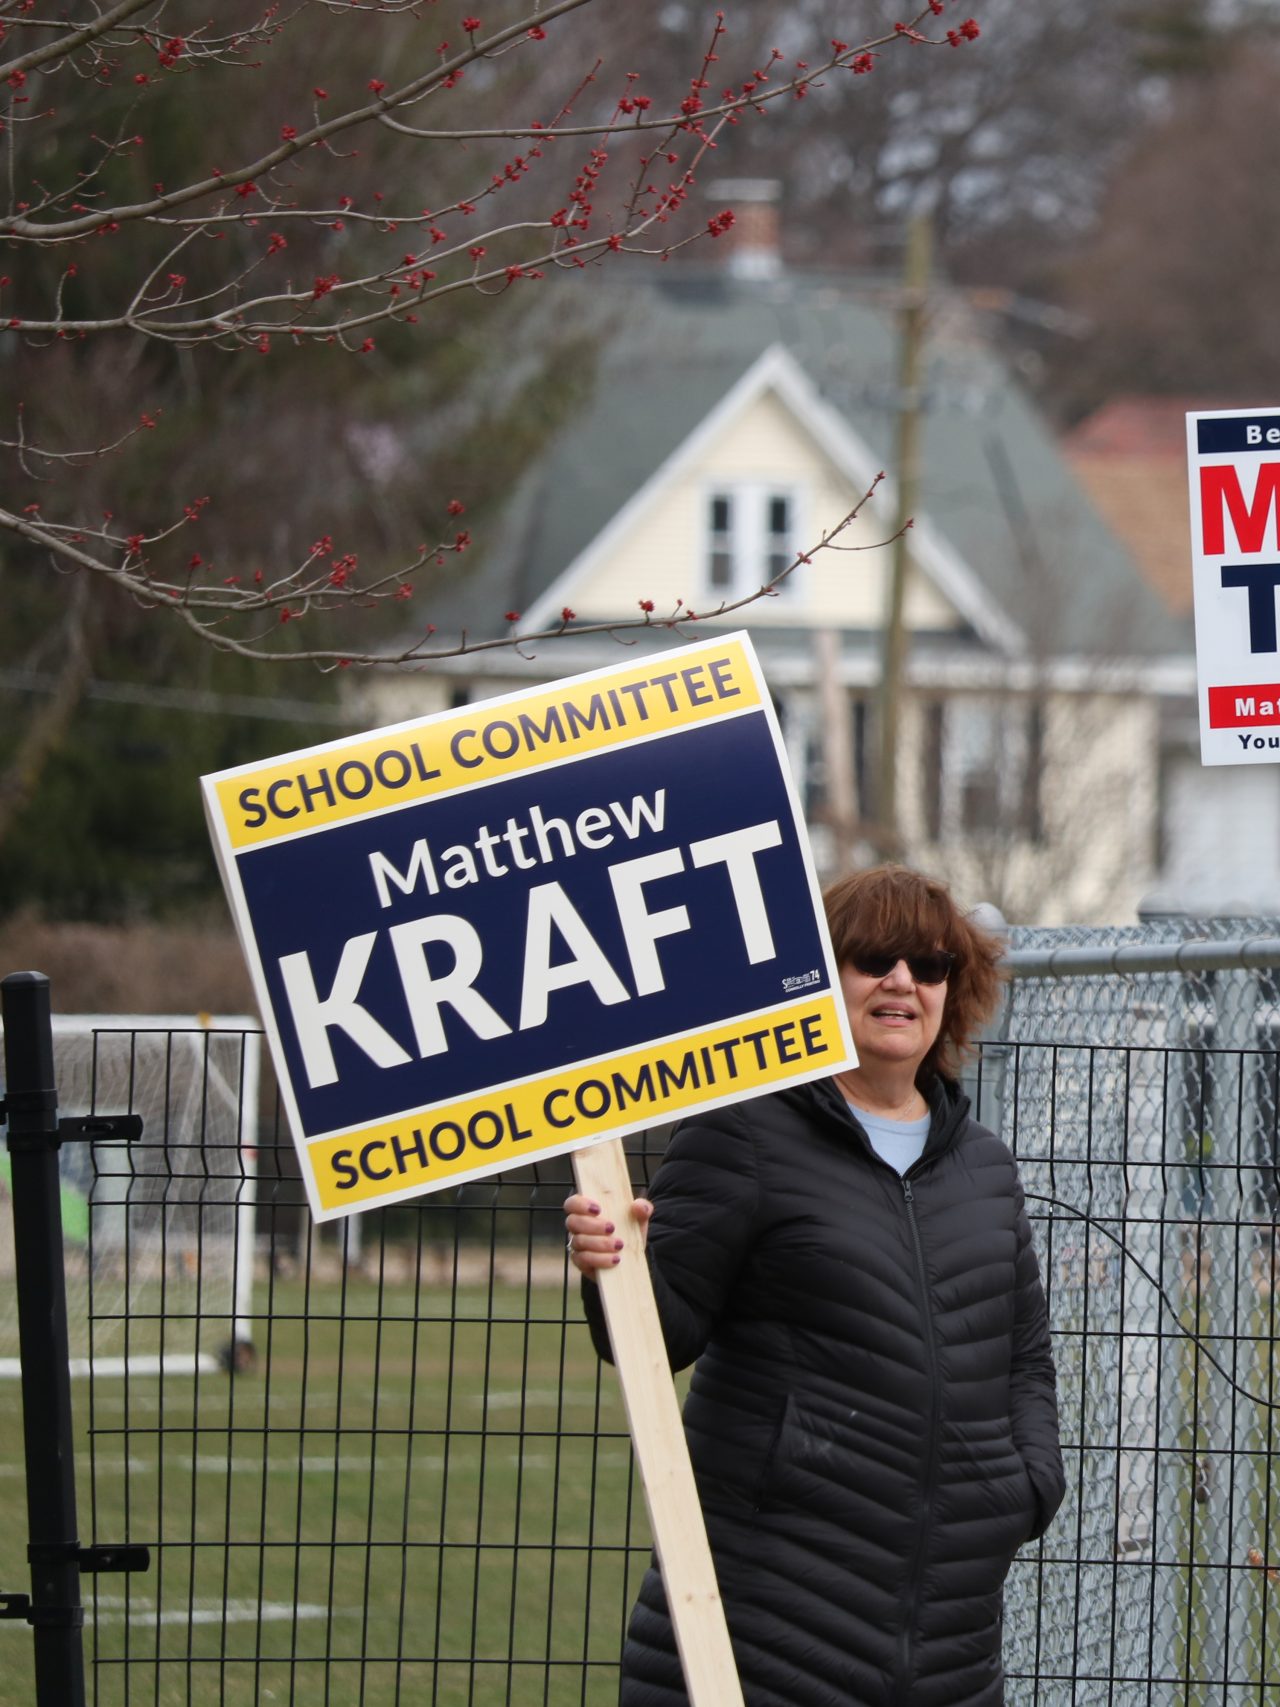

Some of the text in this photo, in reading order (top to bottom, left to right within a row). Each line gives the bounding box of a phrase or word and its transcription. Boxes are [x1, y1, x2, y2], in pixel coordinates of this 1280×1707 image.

[238, 658, 742, 828] SCHOOL COMMITTEE
[368, 789, 666, 908] Matthew
[278, 820, 783, 1089] KRAFT
[330, 1014, 828, 1189] SCHOOL COMMITTEE
